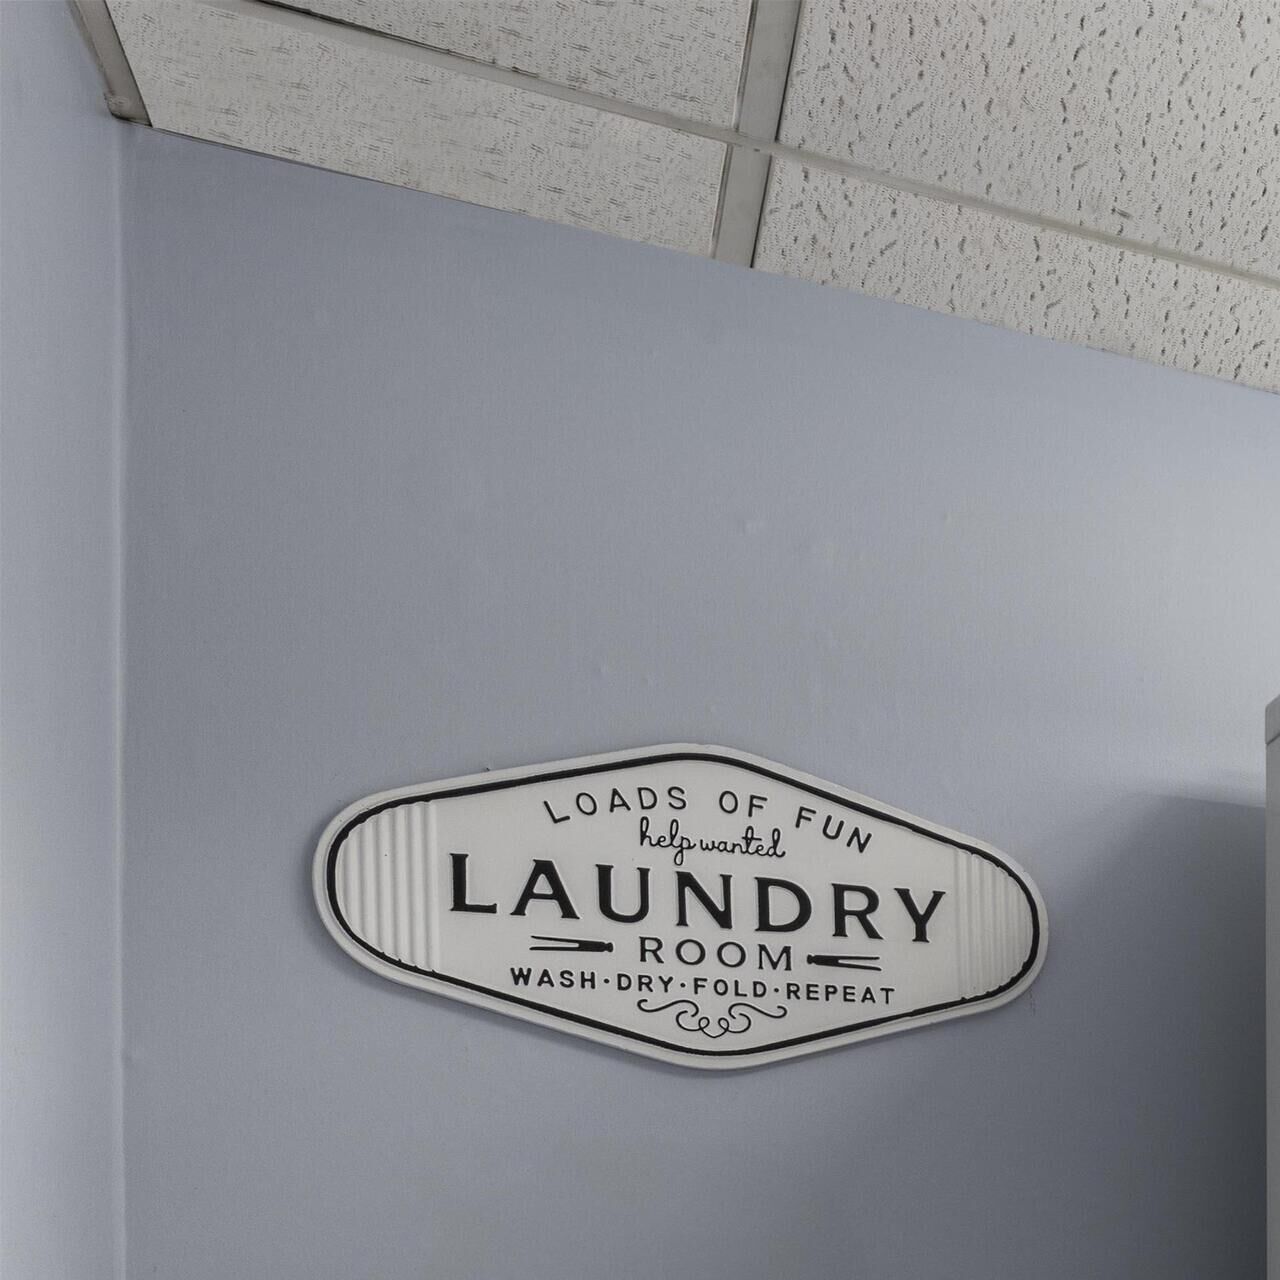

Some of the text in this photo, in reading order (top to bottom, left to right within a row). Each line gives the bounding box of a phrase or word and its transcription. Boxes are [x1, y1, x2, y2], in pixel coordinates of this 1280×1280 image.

[543, 785, 873, 854] LOADS OF FUN
[639, 816, 786, 866] help wanted
[448, 852, 946, 944] LAUNDRY
[638, 935, 793, 972] ROOM
[786, 982, 896, 1005] REPEAT
